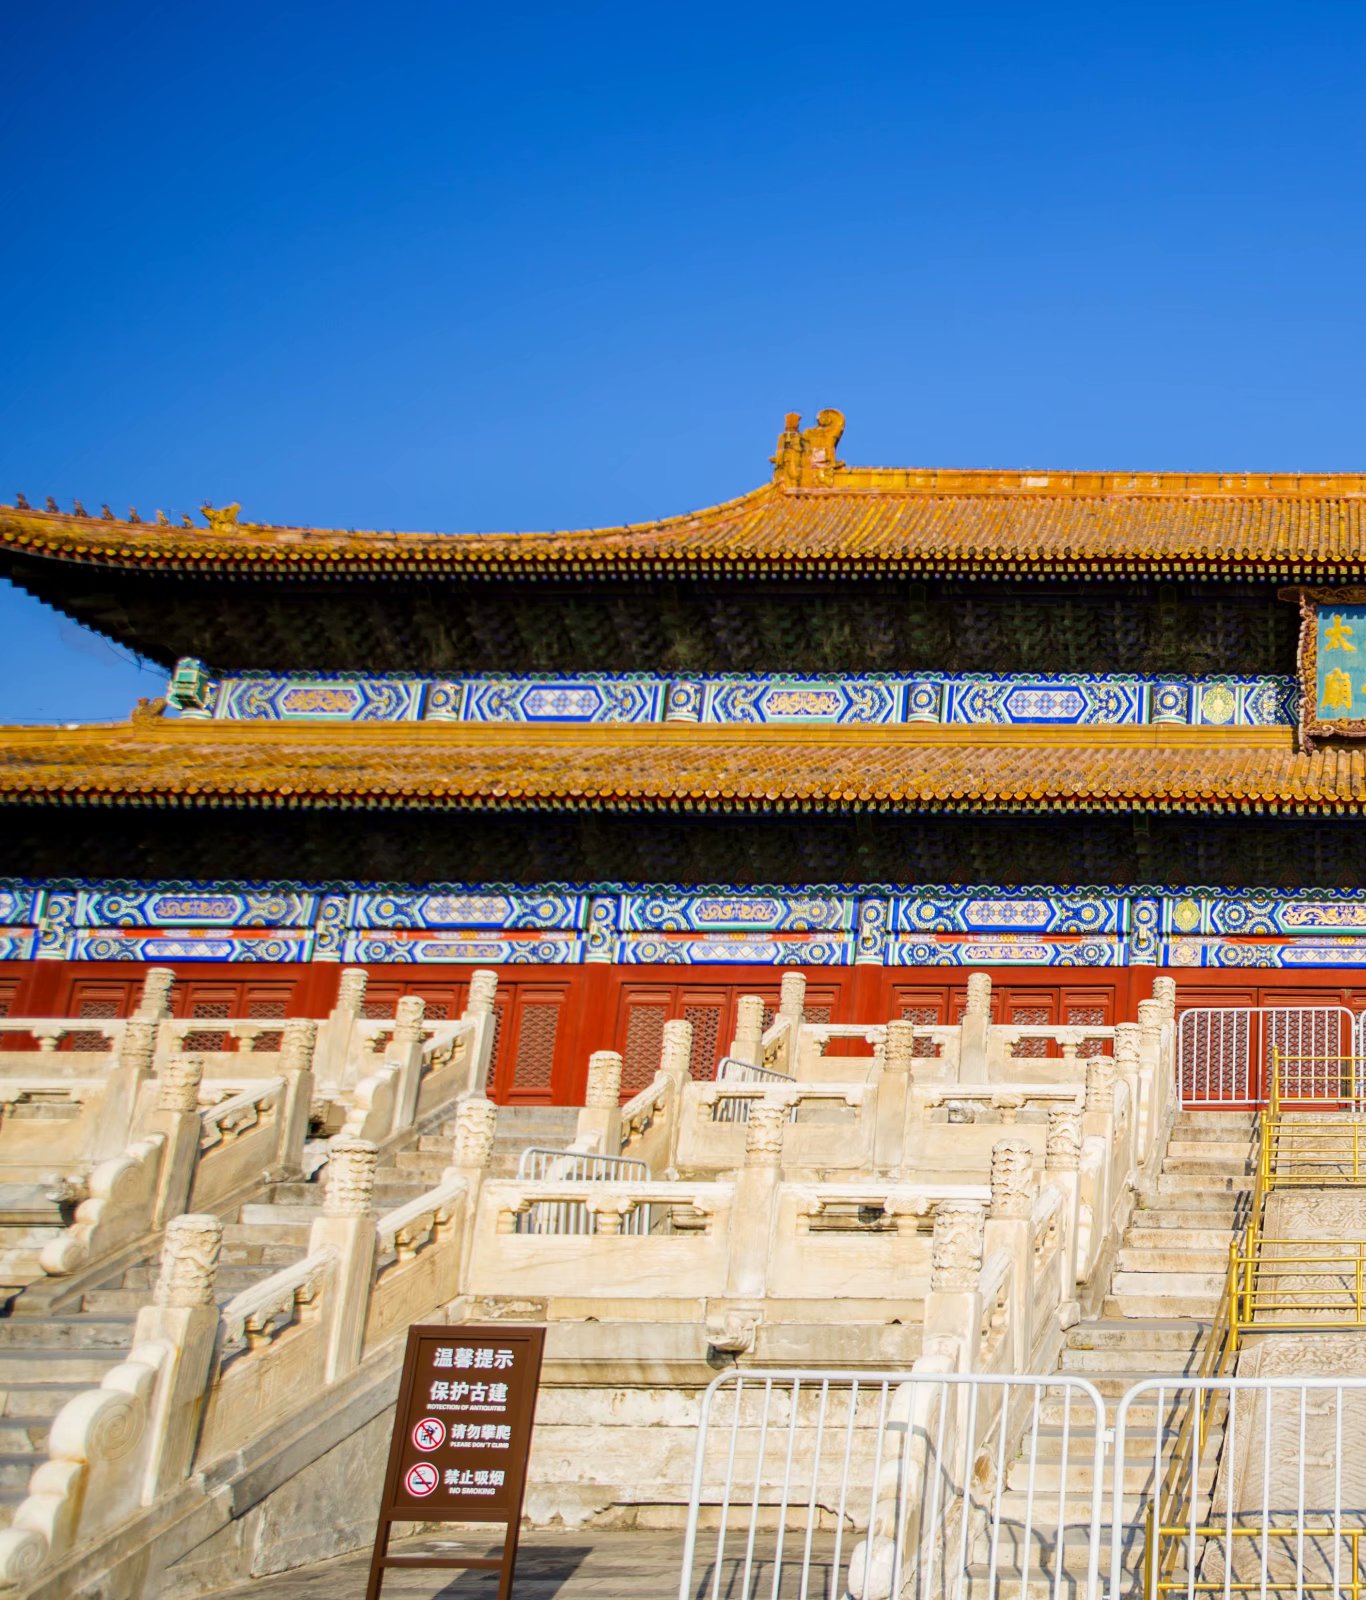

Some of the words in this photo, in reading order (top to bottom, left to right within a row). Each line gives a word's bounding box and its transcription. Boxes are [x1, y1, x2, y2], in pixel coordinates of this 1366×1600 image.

[432, 1347, 515, 1369] 温馨提示
[429, 1380, 508, 1402] 保护古建
[450, 1423, 512, 1441] 请勿攀爬
[443, 1469, 505, 1487] 禁止吸烟
[461, 1487, 496, 1496] SMOKING
